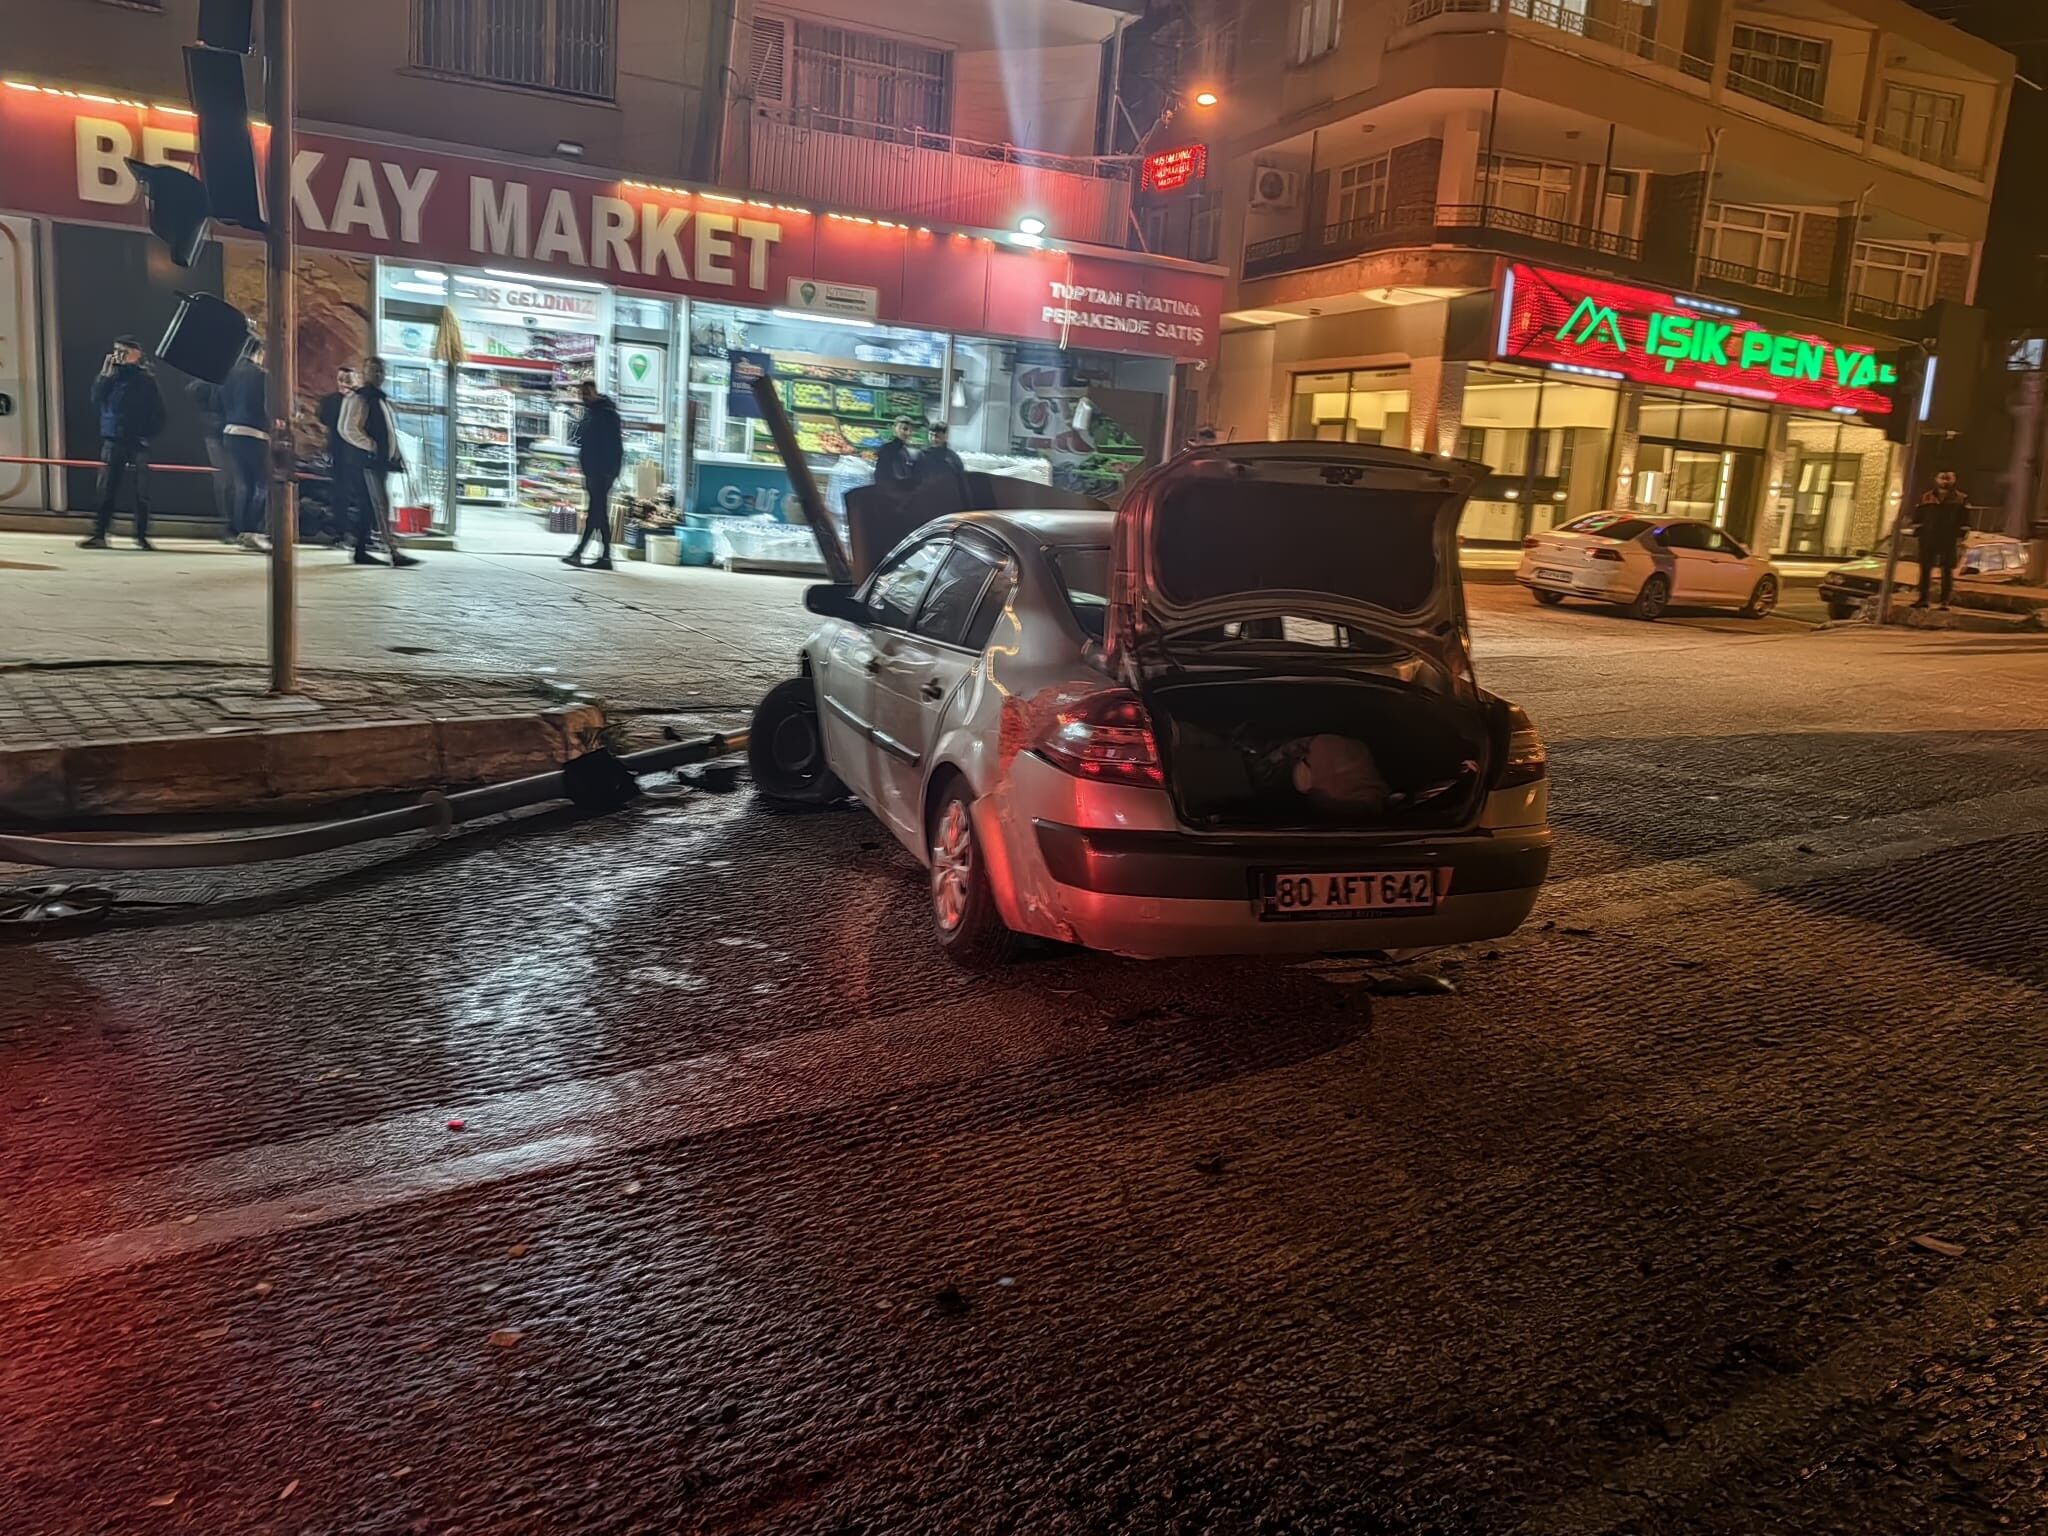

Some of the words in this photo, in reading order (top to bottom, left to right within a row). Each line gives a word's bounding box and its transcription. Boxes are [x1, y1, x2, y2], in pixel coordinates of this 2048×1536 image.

[75, 116, 439, 244] BEKAY
[469, 176, 782, 291] MARKET
[1049, 282, 1123, 307] TOPTAN
[1125, 290, 1202, 318] FİYATINA
[1041, 306, 1151, 335] PERAKENDE
[1155, 322, 1205, 346] SATIŞ
[1645, 312, 1734, 373] IŞIK
[1739, 330, 1825, 382] PEN
[1278, 877, 1314, 908] 80
[1326, 875, 1377, 906] AFT
[1380, 873, 1430, 905] 642
